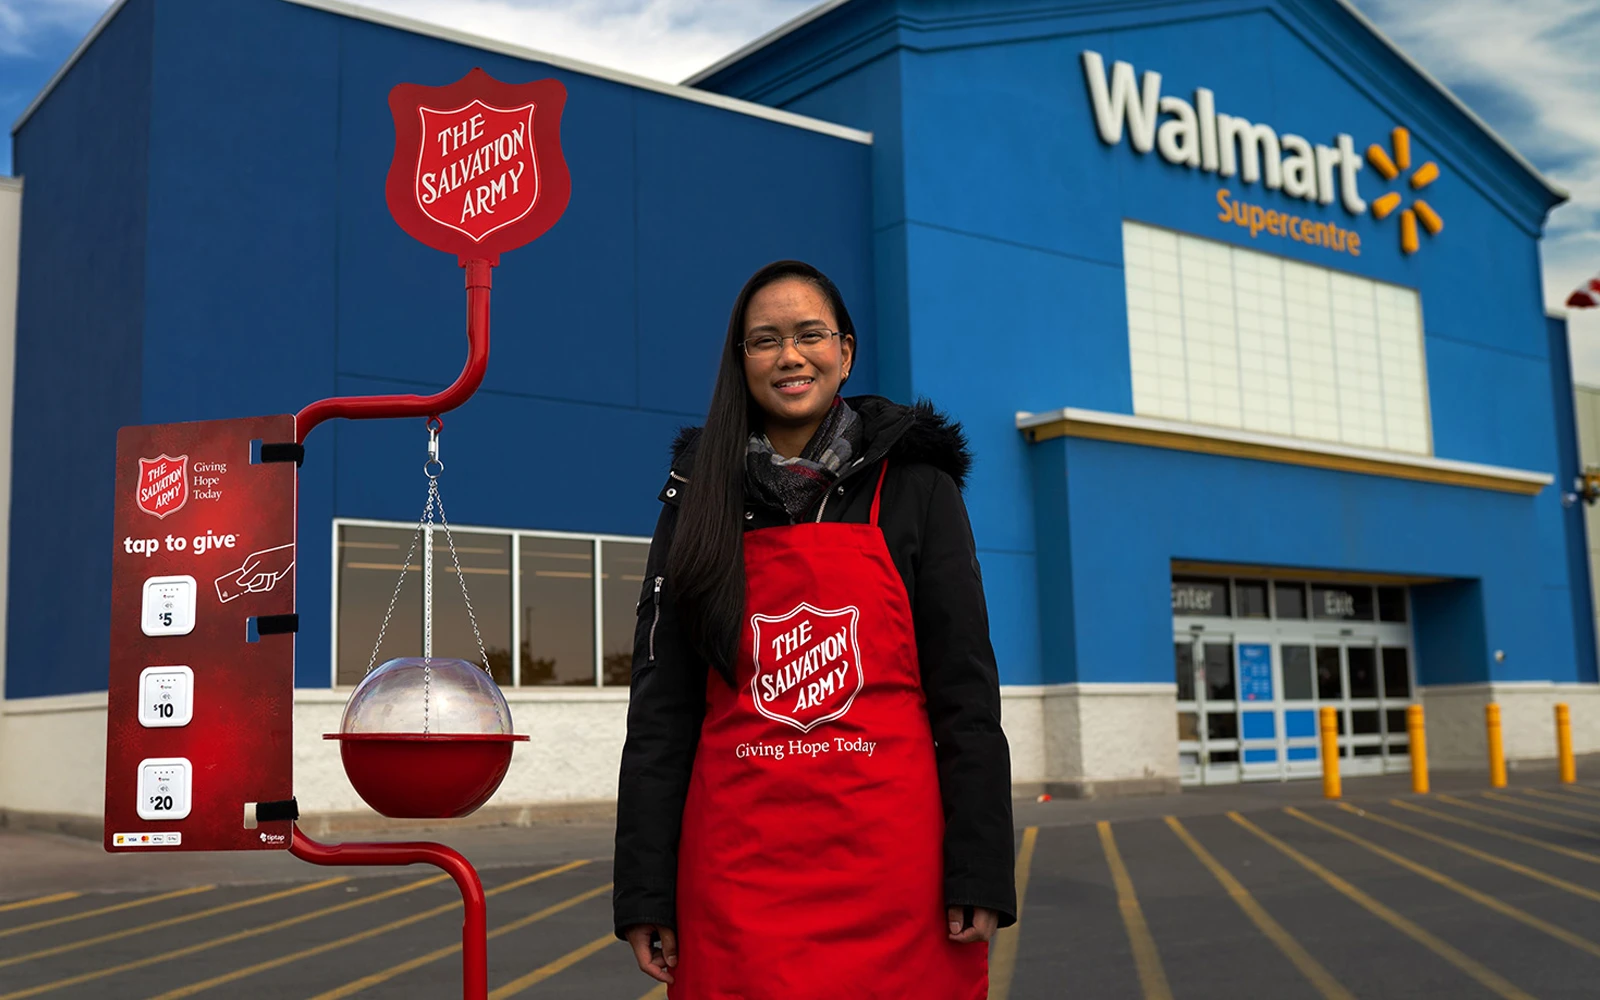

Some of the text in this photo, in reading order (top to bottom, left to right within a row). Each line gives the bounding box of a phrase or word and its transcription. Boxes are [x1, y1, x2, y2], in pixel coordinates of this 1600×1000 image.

[438, 113, 485, 157] THE
[1083, 49, 1367, 215] Walmart
[422, 122, 525, 204] SALVATION
[460, 161, 524, 224] ARMY
[1217, 189, 1361, 256] Supercentre
[148, 462, 167, 482] THE
[194, 462, 227, 474] Giving
[141, 466, 182, 502] SALVATION
[193, 489, 222, 501] Today
[194, 476, 219, 488] Hope
[155, 482, 181, 510] ARMY
[124, 530, 236, 557] tap to give
[1323, 590, 1354, 616] Exit
[159, 612, 172, 627] $5
[772, 619, 813, 661] THE
[761, 626, 847, 702] SALVATION
[792, 660, 848, 713] ARMY
[153, 703, 174, 718] $10
[736, 737, 876, 760] Giving Hope Today
[150, 796, 173, 811] $20
